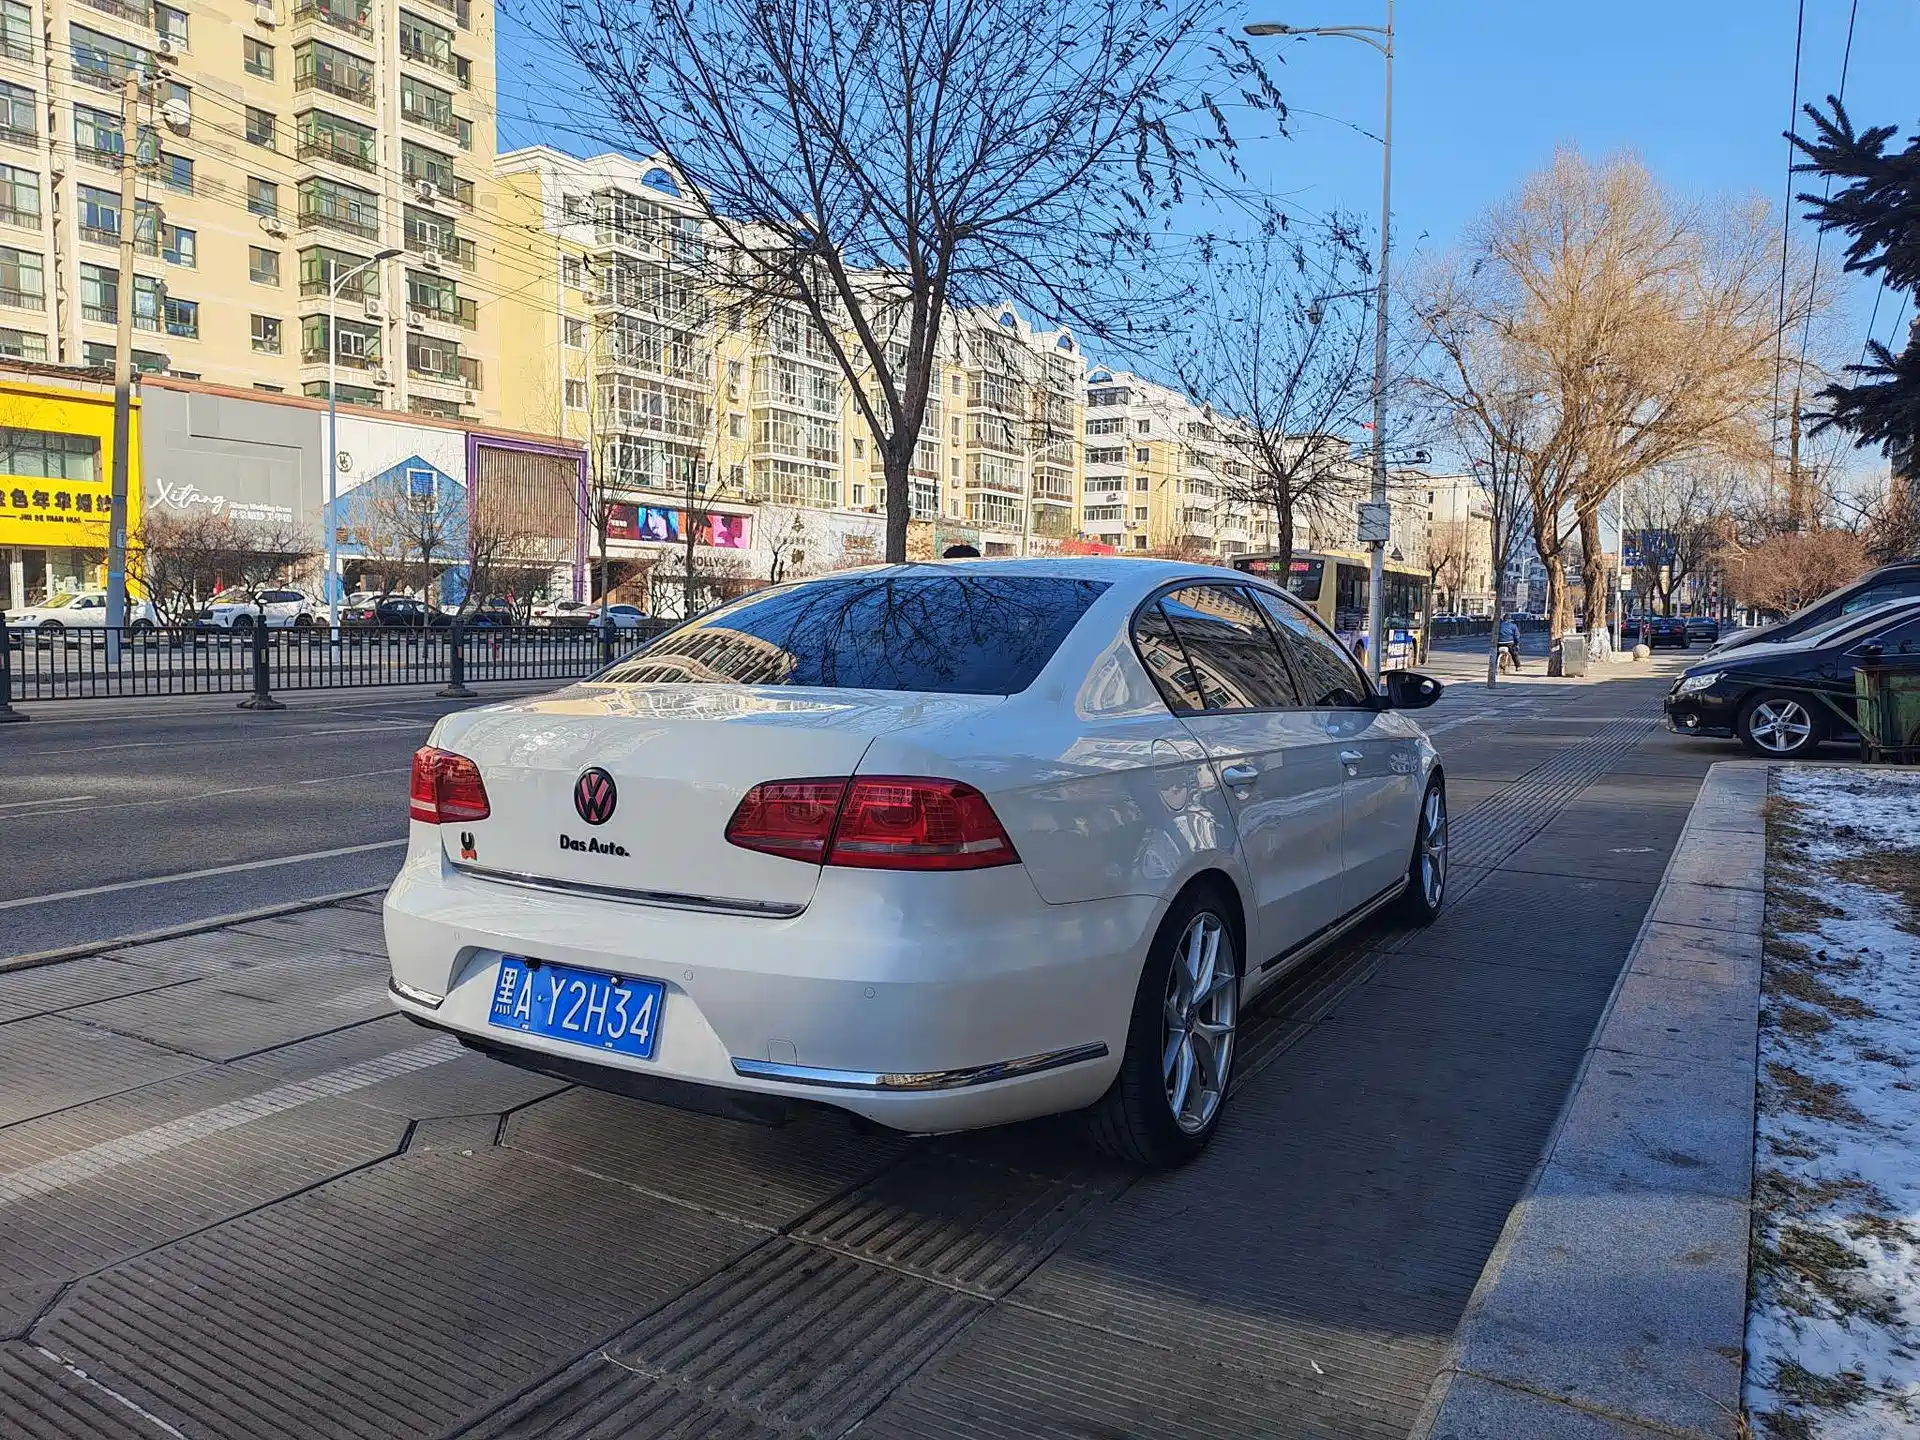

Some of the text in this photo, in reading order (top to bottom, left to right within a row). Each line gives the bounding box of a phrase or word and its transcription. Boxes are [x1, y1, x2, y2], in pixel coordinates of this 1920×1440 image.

[0, 487, 111, 513] 色年华婚纱
[148, 478, 227, 515] Xitang
[559, 834, 631, 858] Das Auto.
